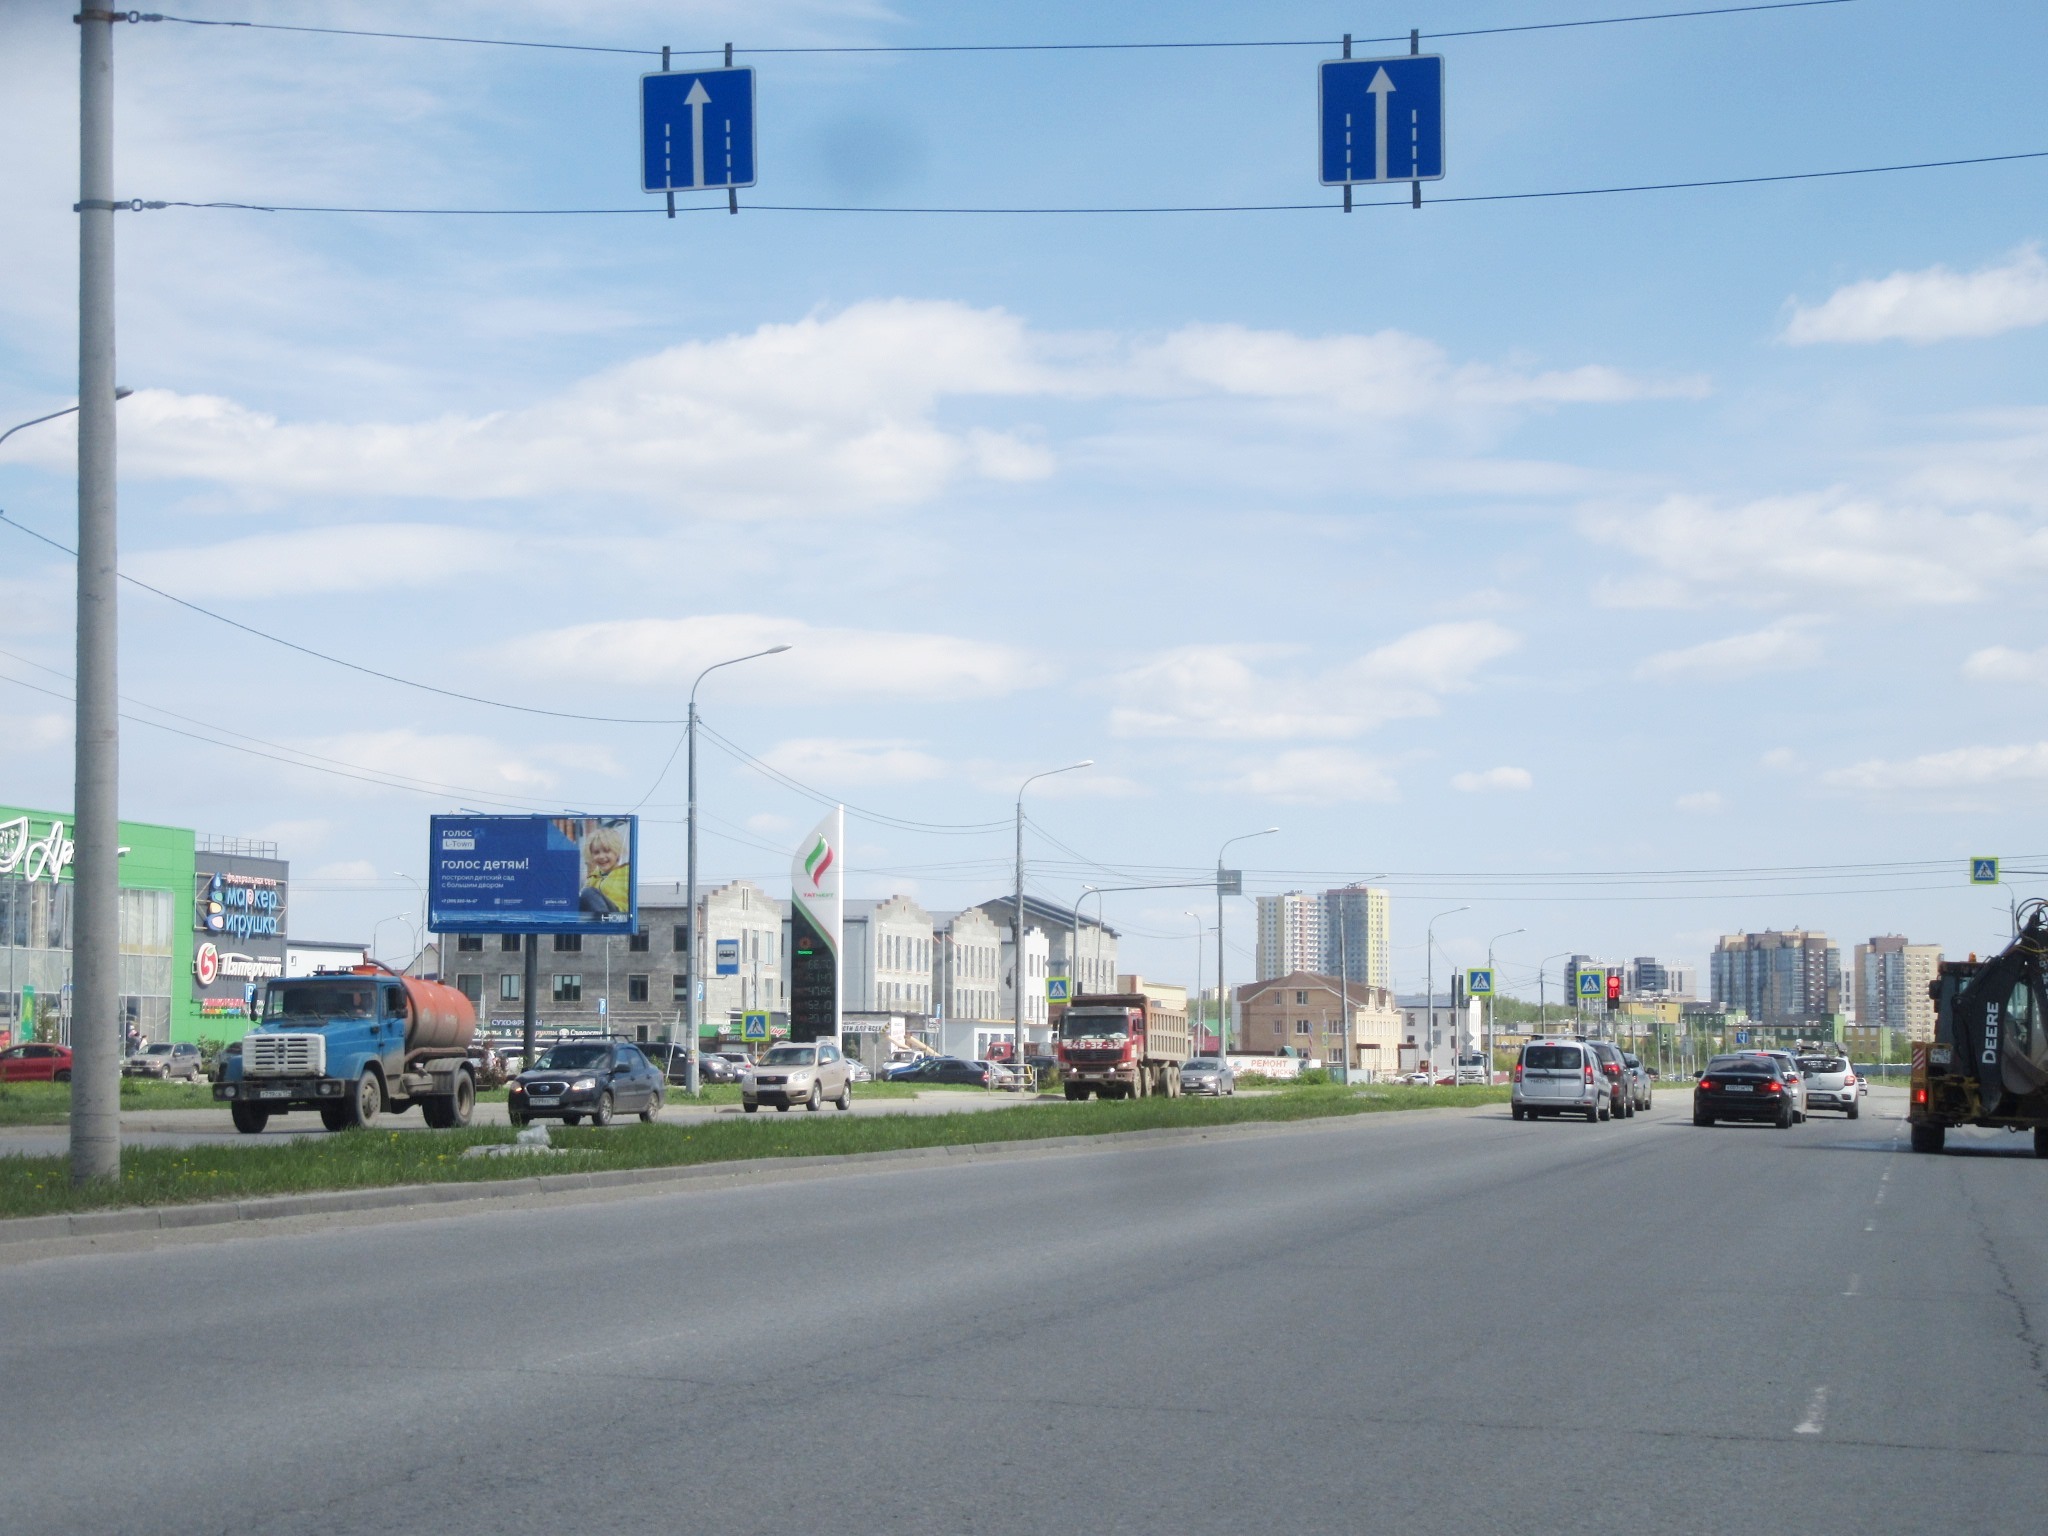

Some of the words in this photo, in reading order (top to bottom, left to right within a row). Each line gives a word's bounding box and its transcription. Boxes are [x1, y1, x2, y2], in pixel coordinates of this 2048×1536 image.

[445, 840, 473, 848] L-Town
[442, 860, 480, 870] голос
[483, 857, 529, 871] детям!
[441, 874, 474, 882] построил
[474, 873, 502, 881] детский
[226, 887, 277, 914] маркер
[226, 914, 277, 938] игрушка
[1981, 1001, 1999, 1064] DEERE
[1066, 1041, 1120, 1049] 248-32-32
[1251, 1059, 1288, 1067] РЕМОНТ
